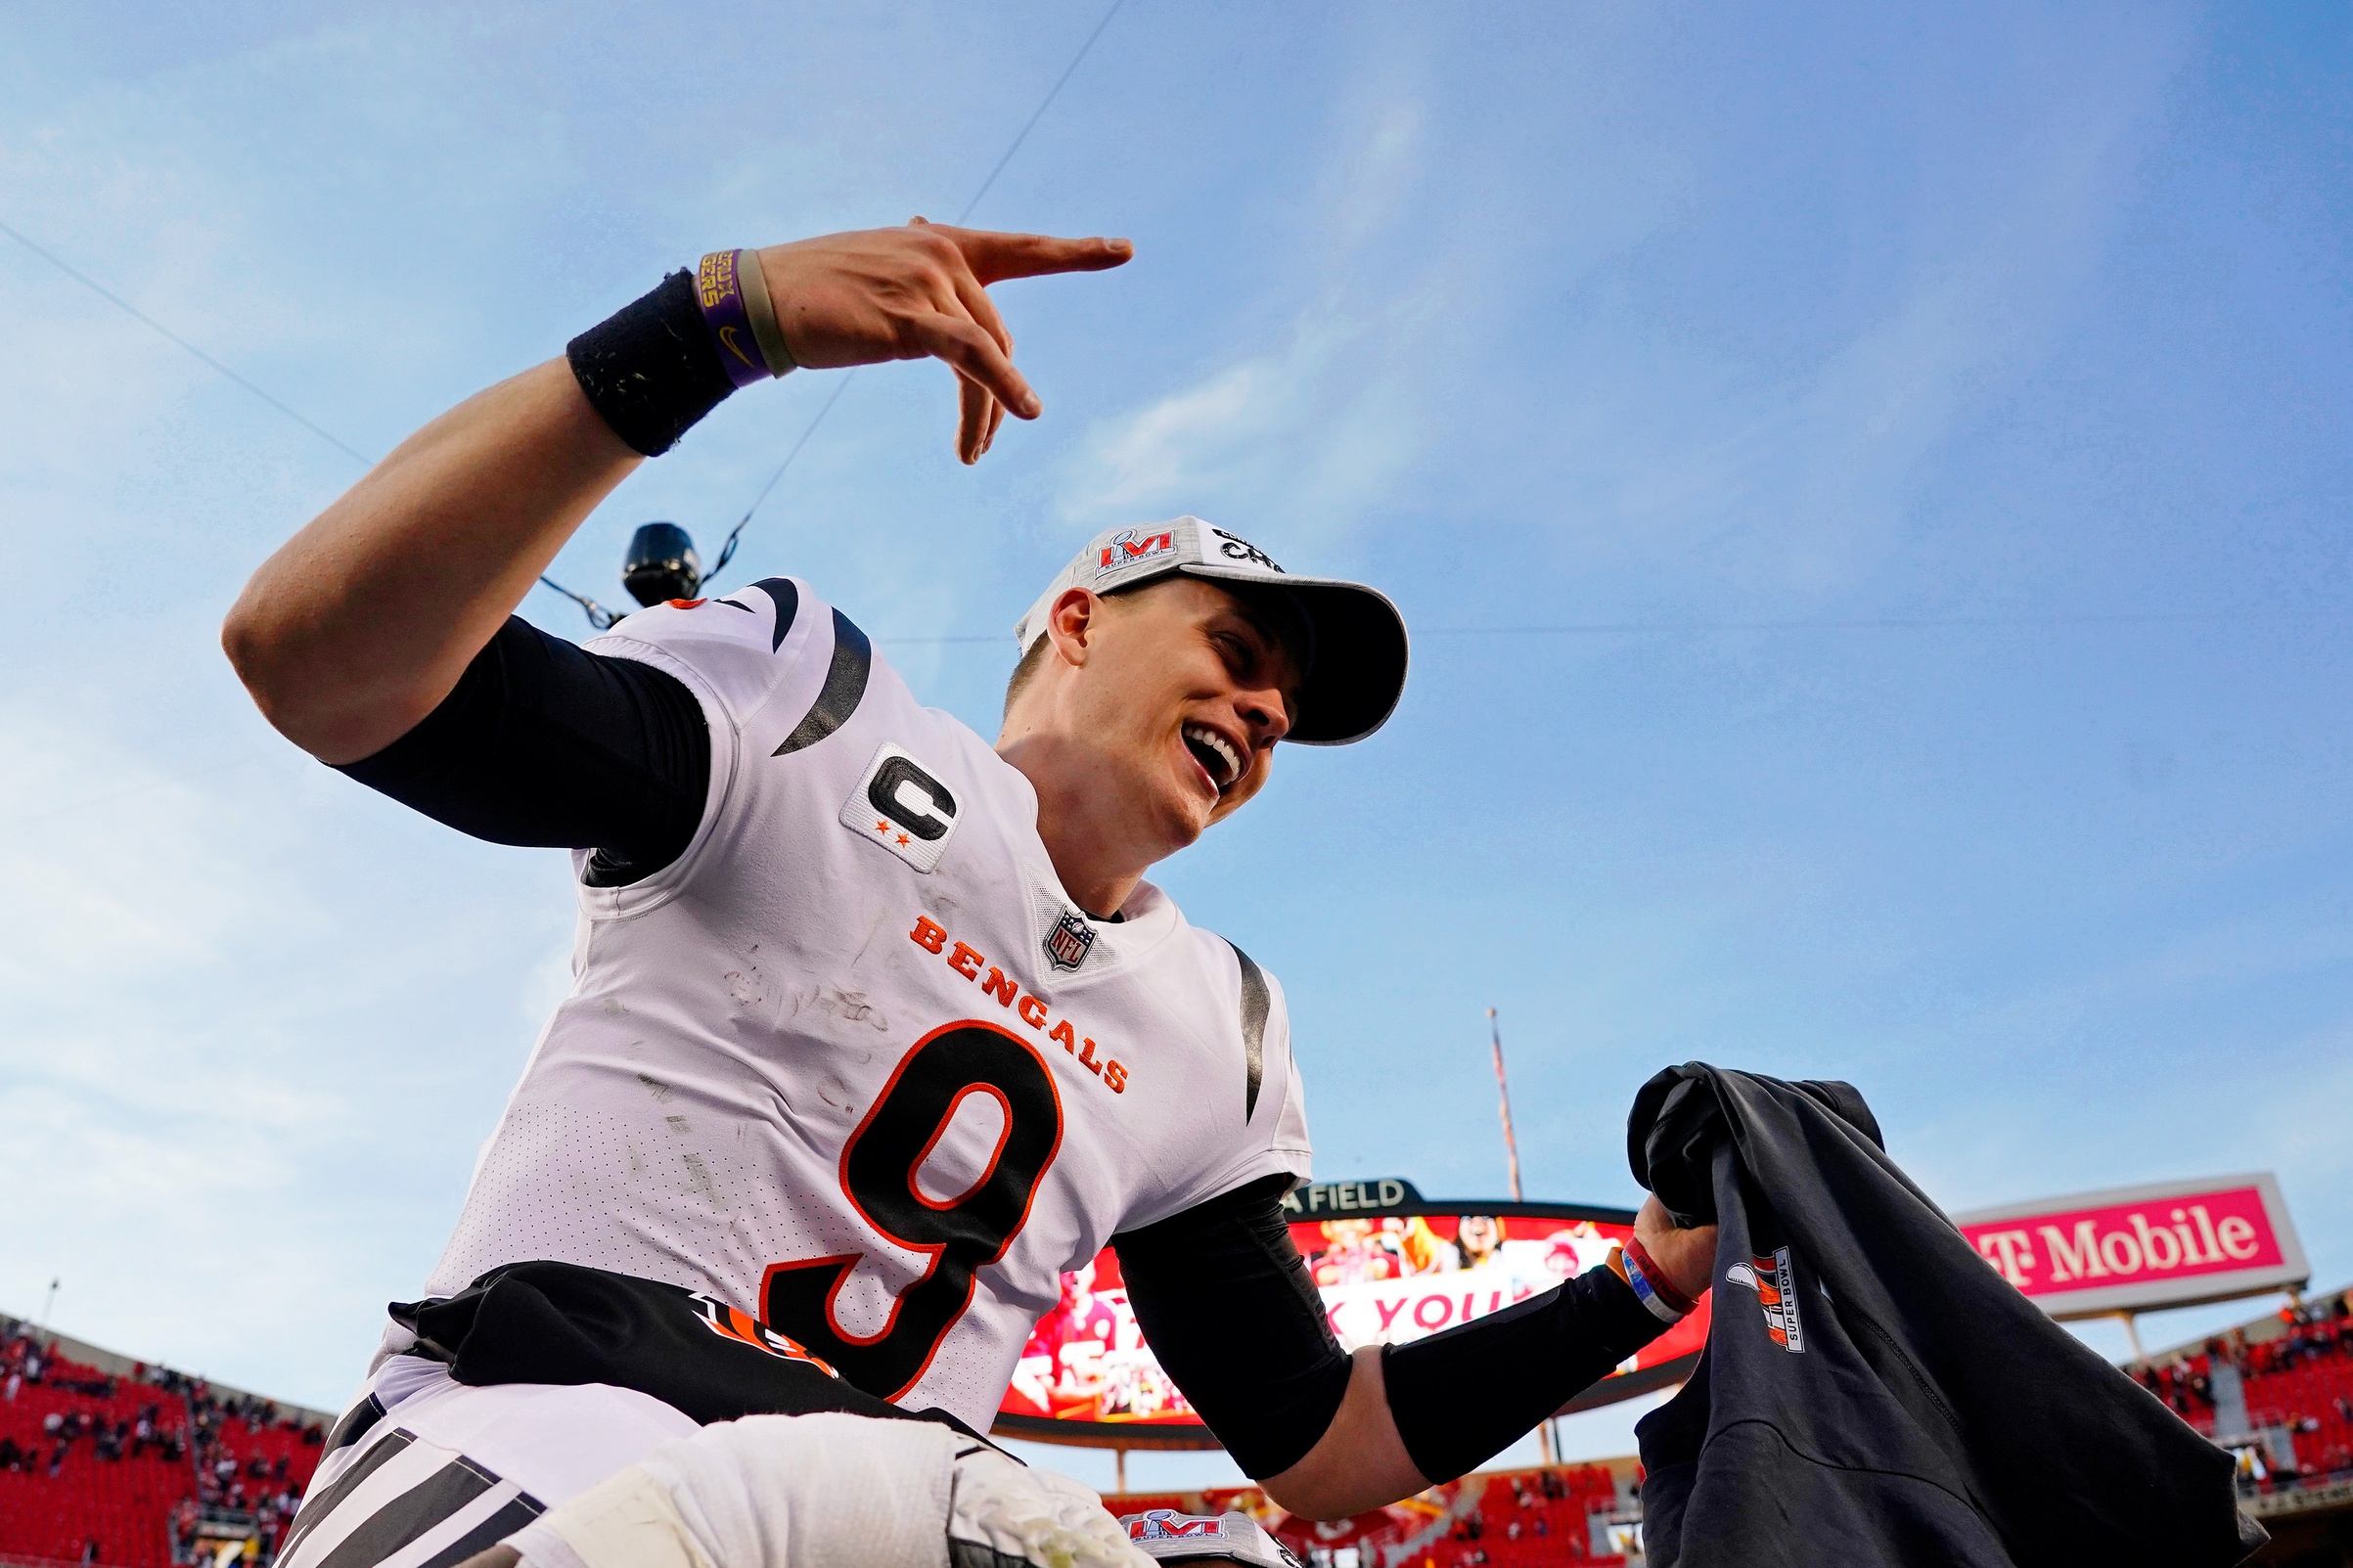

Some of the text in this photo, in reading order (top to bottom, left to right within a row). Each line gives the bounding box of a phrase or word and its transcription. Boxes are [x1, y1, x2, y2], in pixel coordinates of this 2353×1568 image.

[1101, 531, 1171, 567] LVI
[1105, 557, 1135, 569] SUPER
[868, 755, 957, 841] C
[1051, 927, 1082, 963] NFL
[909, 915, 1129, 1095] BENGALS
[759, 1019, 1063, 1404] 9
[1308, 1179, 1405, 1212] FIELD
[1636, 1255, 1652, 1273] ONE
[1375, 1290, 1502, 1331] YOU
[1779, 1259, 1798, 1341] SUPER BOWL
[1130, 1521, 1219, 1539] LVI
